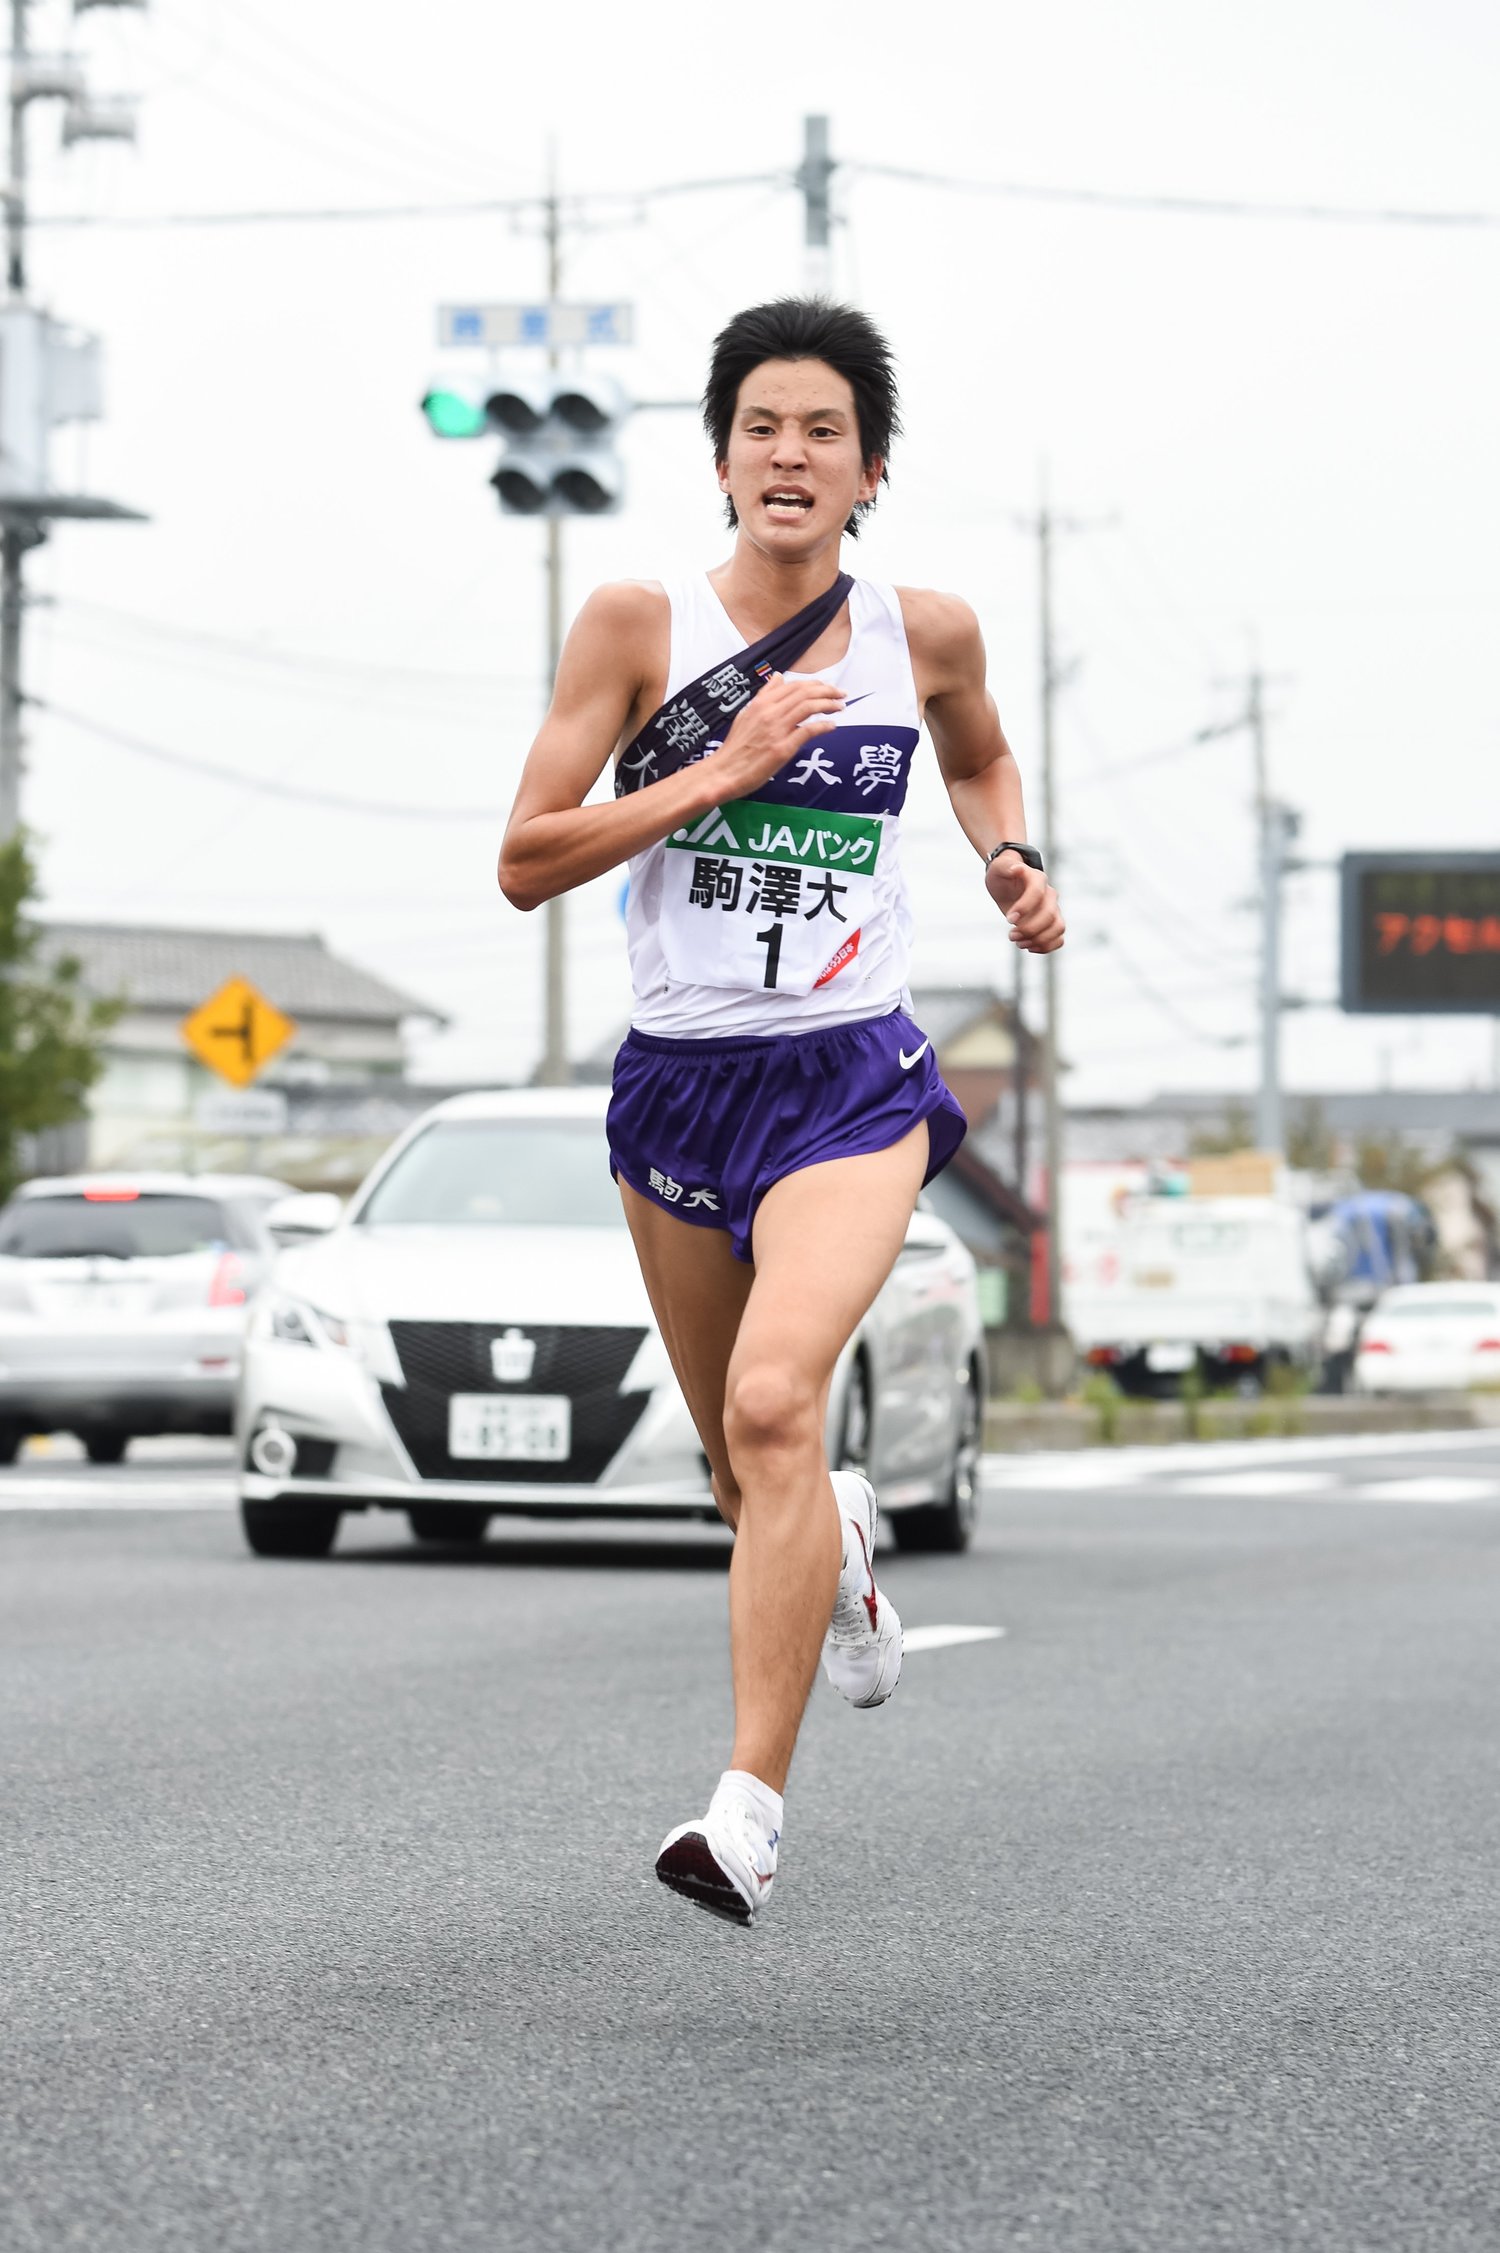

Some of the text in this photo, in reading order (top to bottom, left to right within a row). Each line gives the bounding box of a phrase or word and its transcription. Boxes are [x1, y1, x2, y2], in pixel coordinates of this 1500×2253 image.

[748, 823, 875, 866] JAバンク
[688, 856, 848, 924] 駒澤大
[756, 922, 784, 989] 1
[648, 1167, 721, 1211] 駒大
